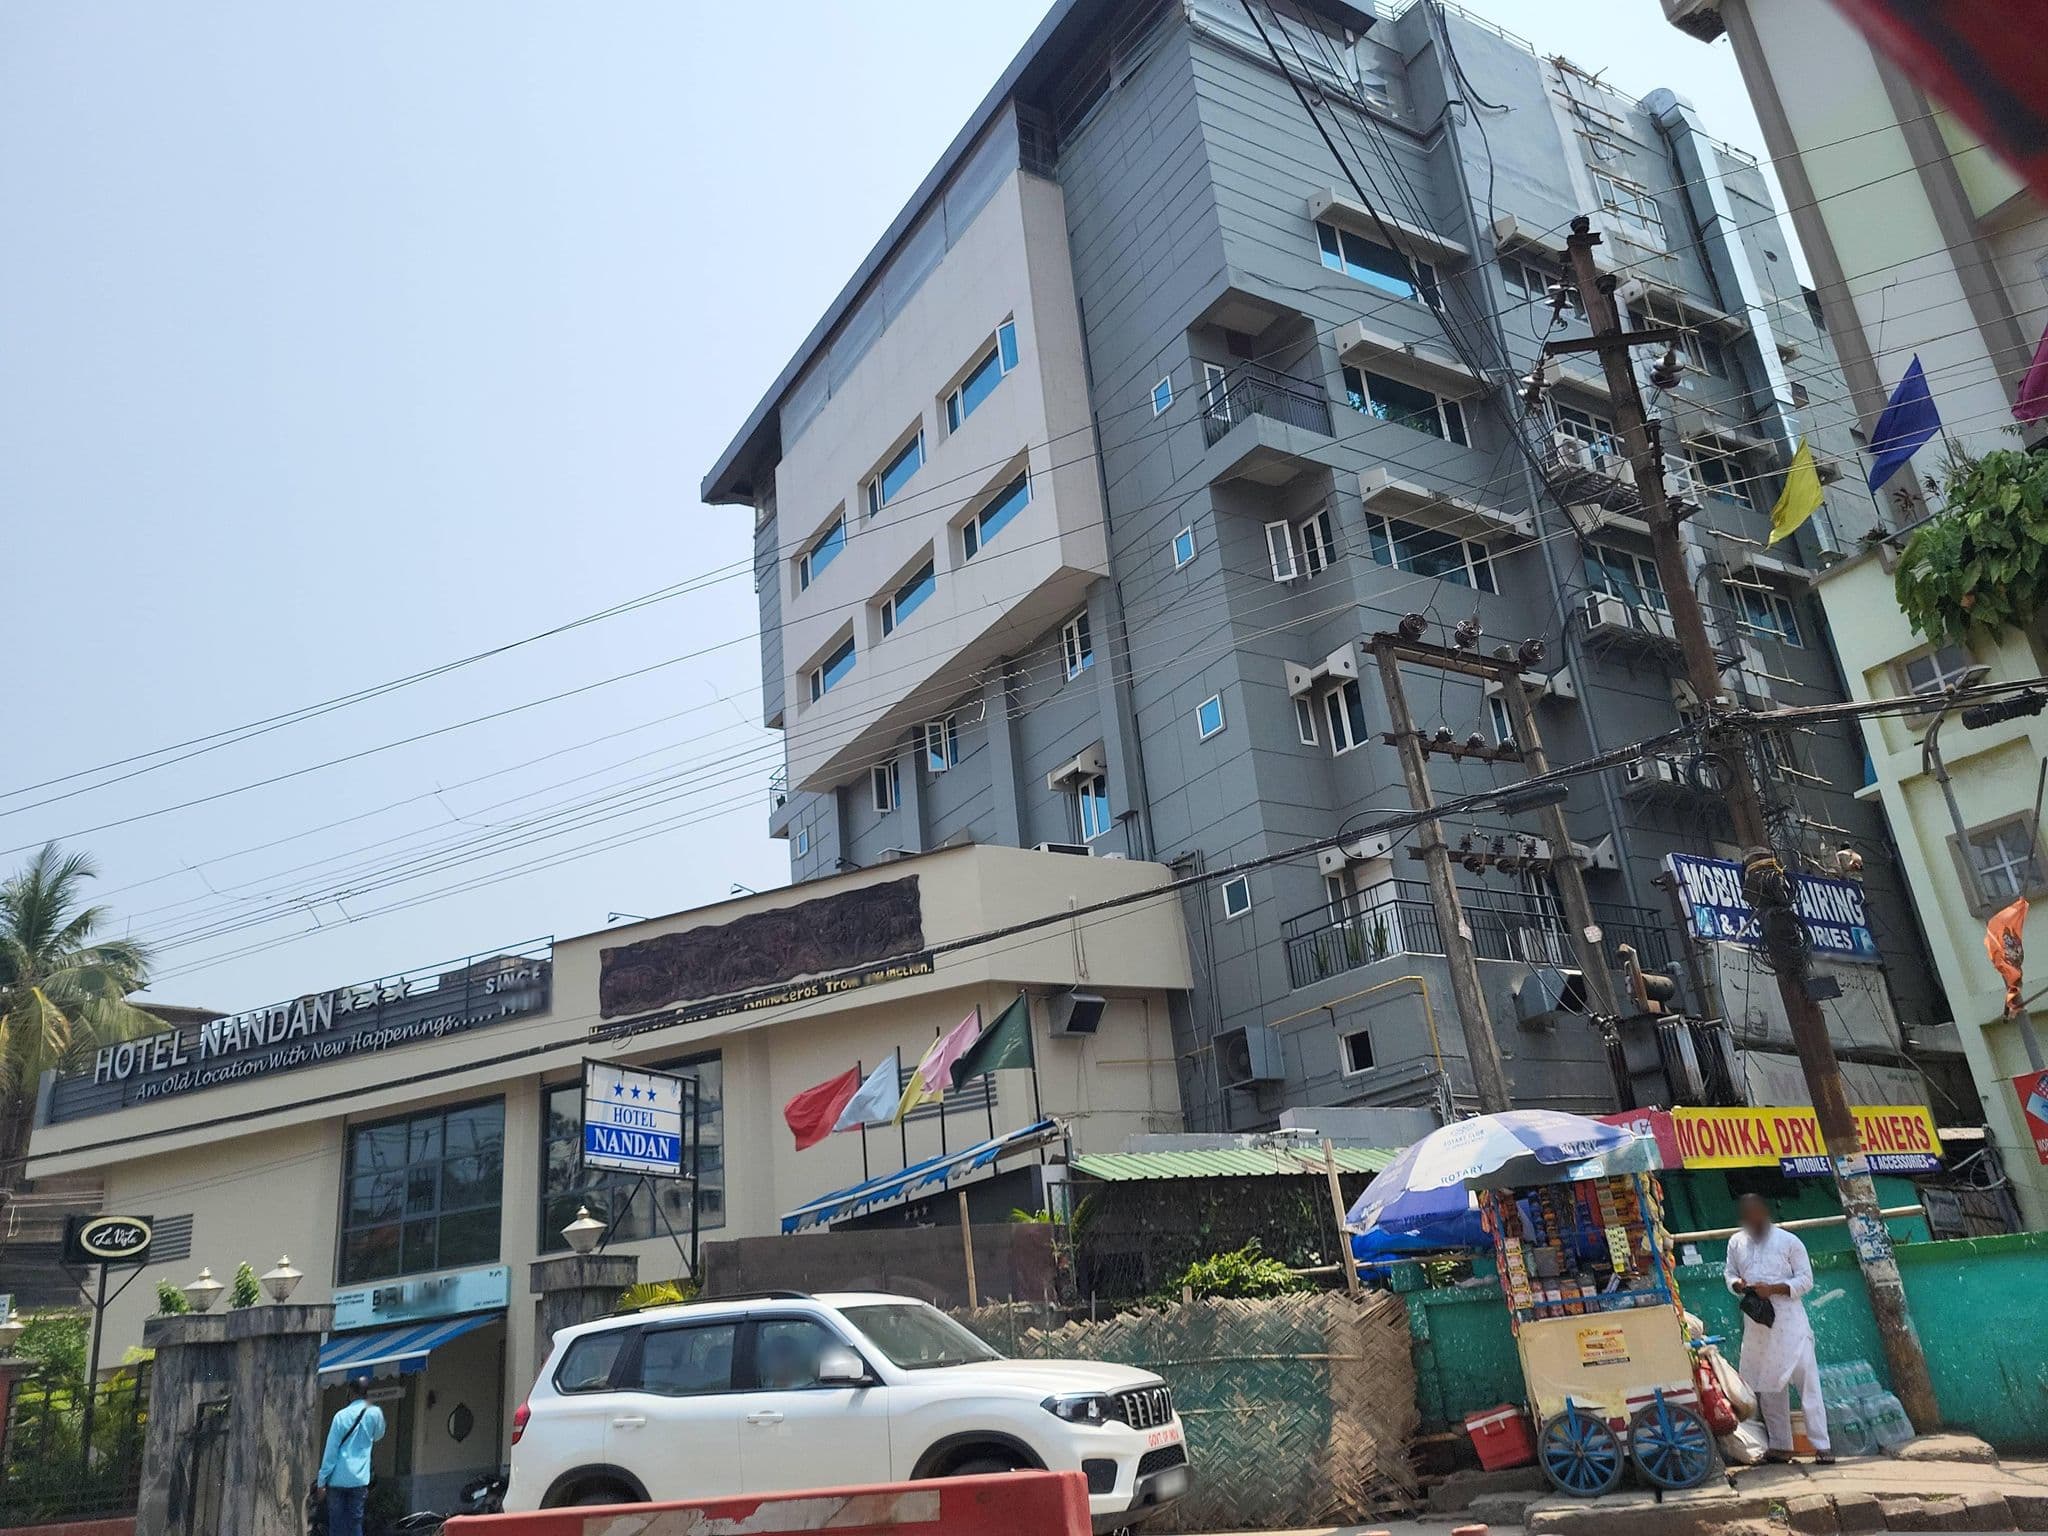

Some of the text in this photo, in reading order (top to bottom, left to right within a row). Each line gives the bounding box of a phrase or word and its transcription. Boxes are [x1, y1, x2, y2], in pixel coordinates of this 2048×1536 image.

[1680, 862, 1751, 910] MOBIL
[1720, 913, 1735, 935] &
[94, 994, 335, 1084] HOTEL NANDAN
[136, 1083, 161, 1100] An
[162, 1073, 194, 1094] Old
[194, 1058, 268, 1087] Location
[269, 1043, 310, 1070] With
[311, 1040, 346, 1060] New
[613, 1107, 657, 1128] HOTEL
[593, 1128, 670, 1160] NANDAN
[1676, 1118, 1774, 1157] MONIKA
[1773, 1118, 1820, 1154] DRY
[1851, 1115, 1931, 1151] EANERS
[1441, 1164, 1483, 1184] ROTARY
[1794, 1157, 1829, 1173] MOBILE
[1878, 1154, 1930, 1171] ACCESSORIES
